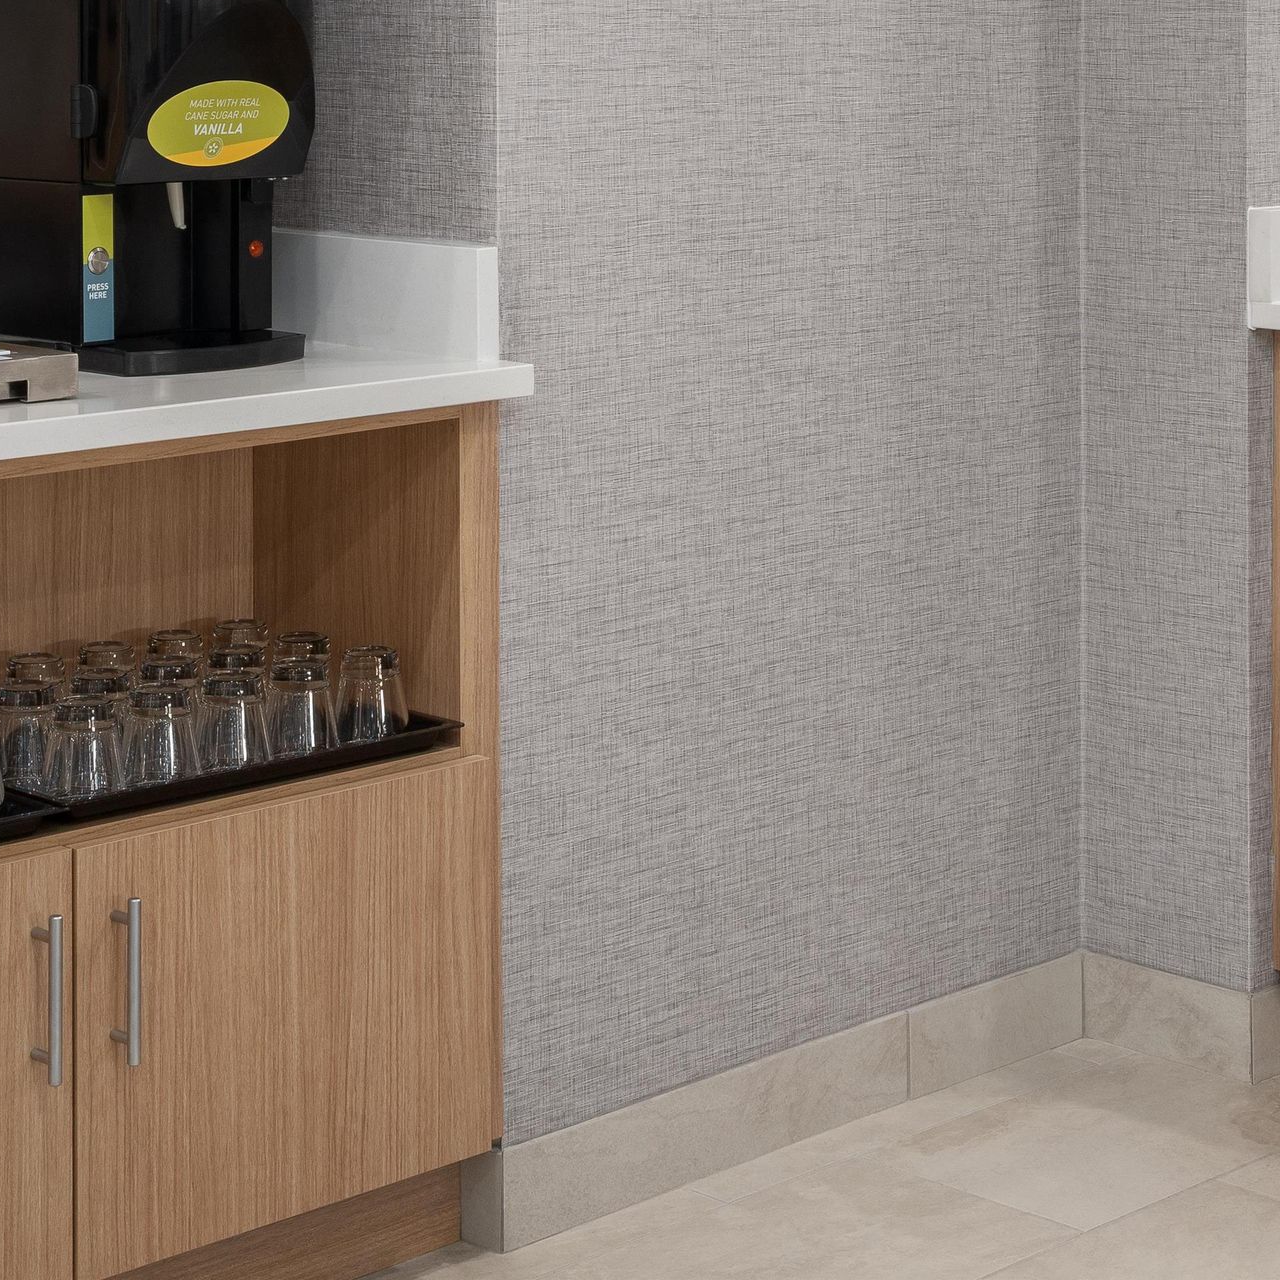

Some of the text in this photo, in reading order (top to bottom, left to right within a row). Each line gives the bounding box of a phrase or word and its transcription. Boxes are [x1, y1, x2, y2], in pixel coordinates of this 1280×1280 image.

[189, 97, 260, 109] MADE WITH REAL
[185, 109, 259, 121] CANE SUGAR AND
[194, 122, 243, 136] VANILLA
[87, 282, 109, 291] PRESS
[89, 291, 108, 300] HERE
